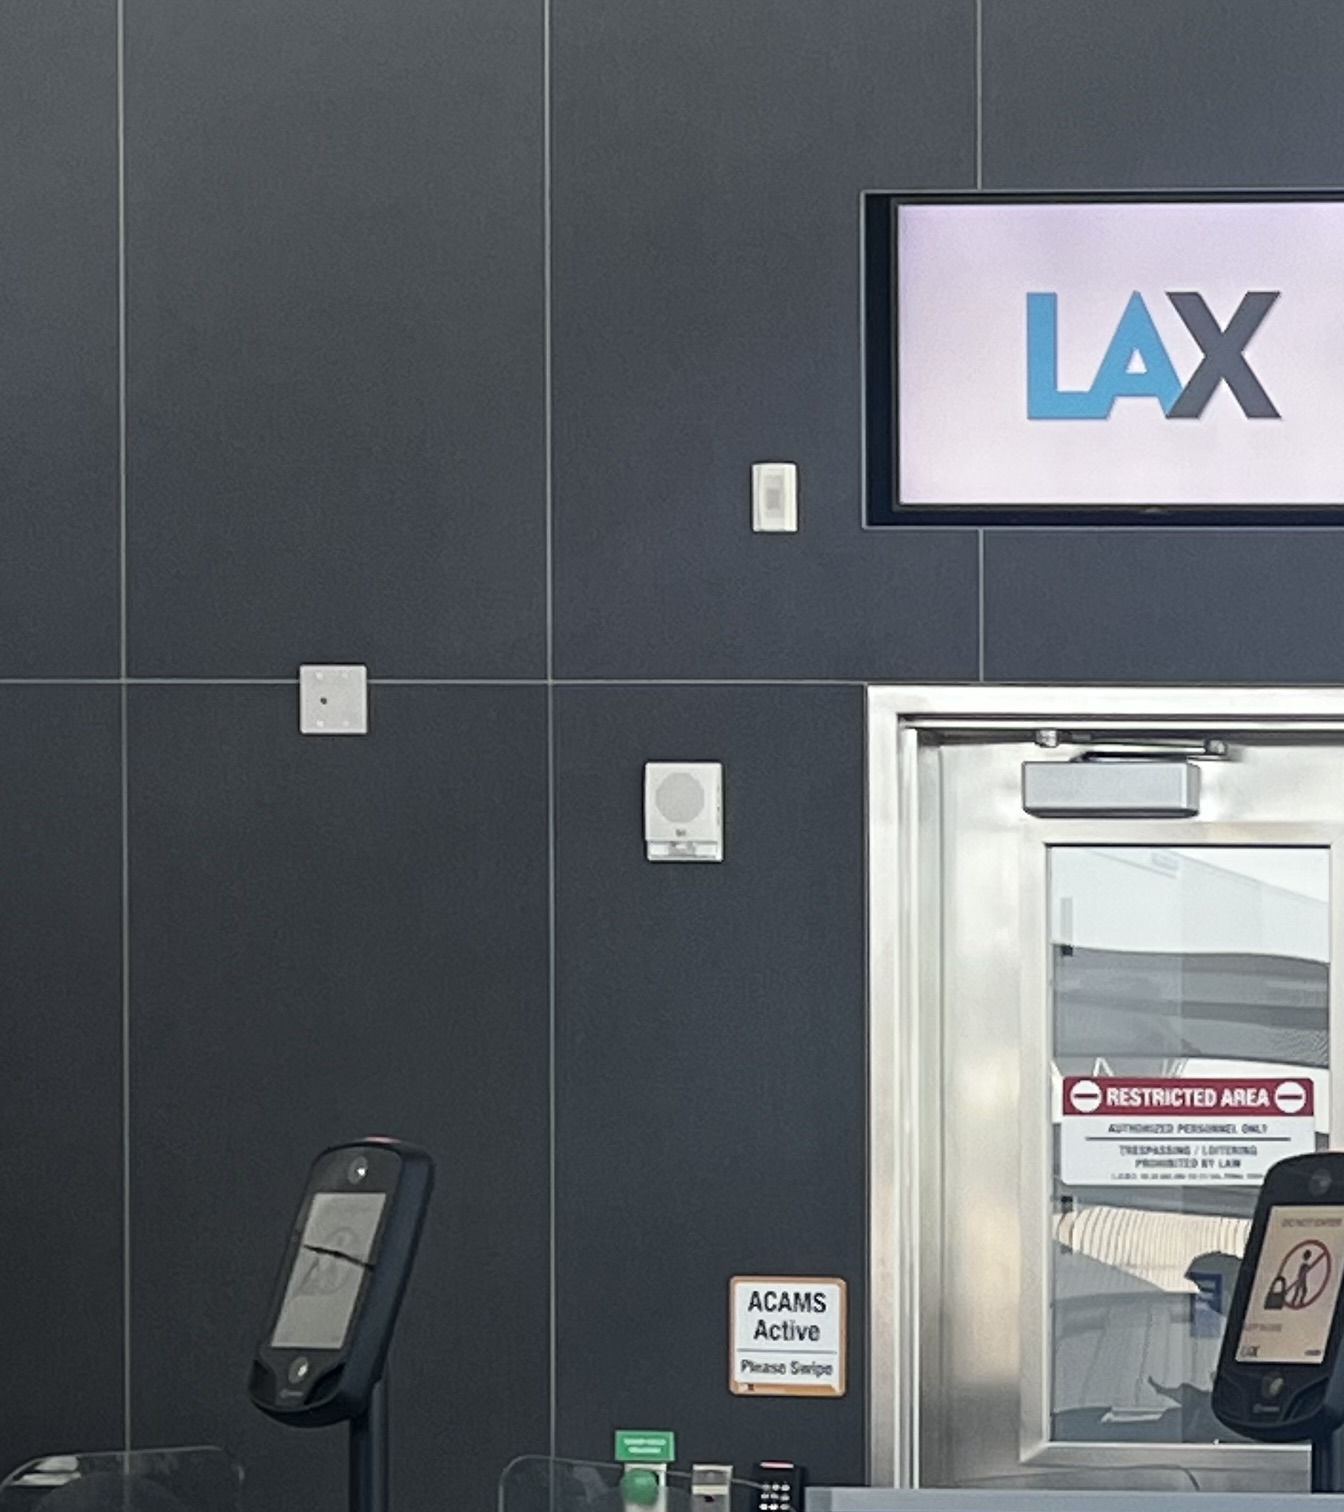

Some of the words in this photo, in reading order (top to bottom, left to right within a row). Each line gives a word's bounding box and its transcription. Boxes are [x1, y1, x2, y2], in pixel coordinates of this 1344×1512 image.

[1025, 290, 1282, 421] LAX
[1106, 1087, 1216, 1108] RESTRICTED
[1220, 1089, 1270, 1108] AREA
[1108, 1123, 1174, 1134] AUTHORIZED
[1177, 1124, 1237, 1134] PERSONNEL
[1241, 1124, 1268, 1134] ONLY
[1119, 1145, 1191, 1156] TRESPASSING
[1201, 1145, 1258, 1156] LOITERING
[1135, 1159, 1198, 1169] PROHIBITED
[1201, 1159, 1215, 1169] BY
[1218, 1159, 1241, 1169] LAW
[748, 1290, 826, 1313] ACAMS
[753, 1319, 820, 1341] Active
[740, 1359, 786, 1375] Please
[790, 1360, 833, 1378] Swipe
